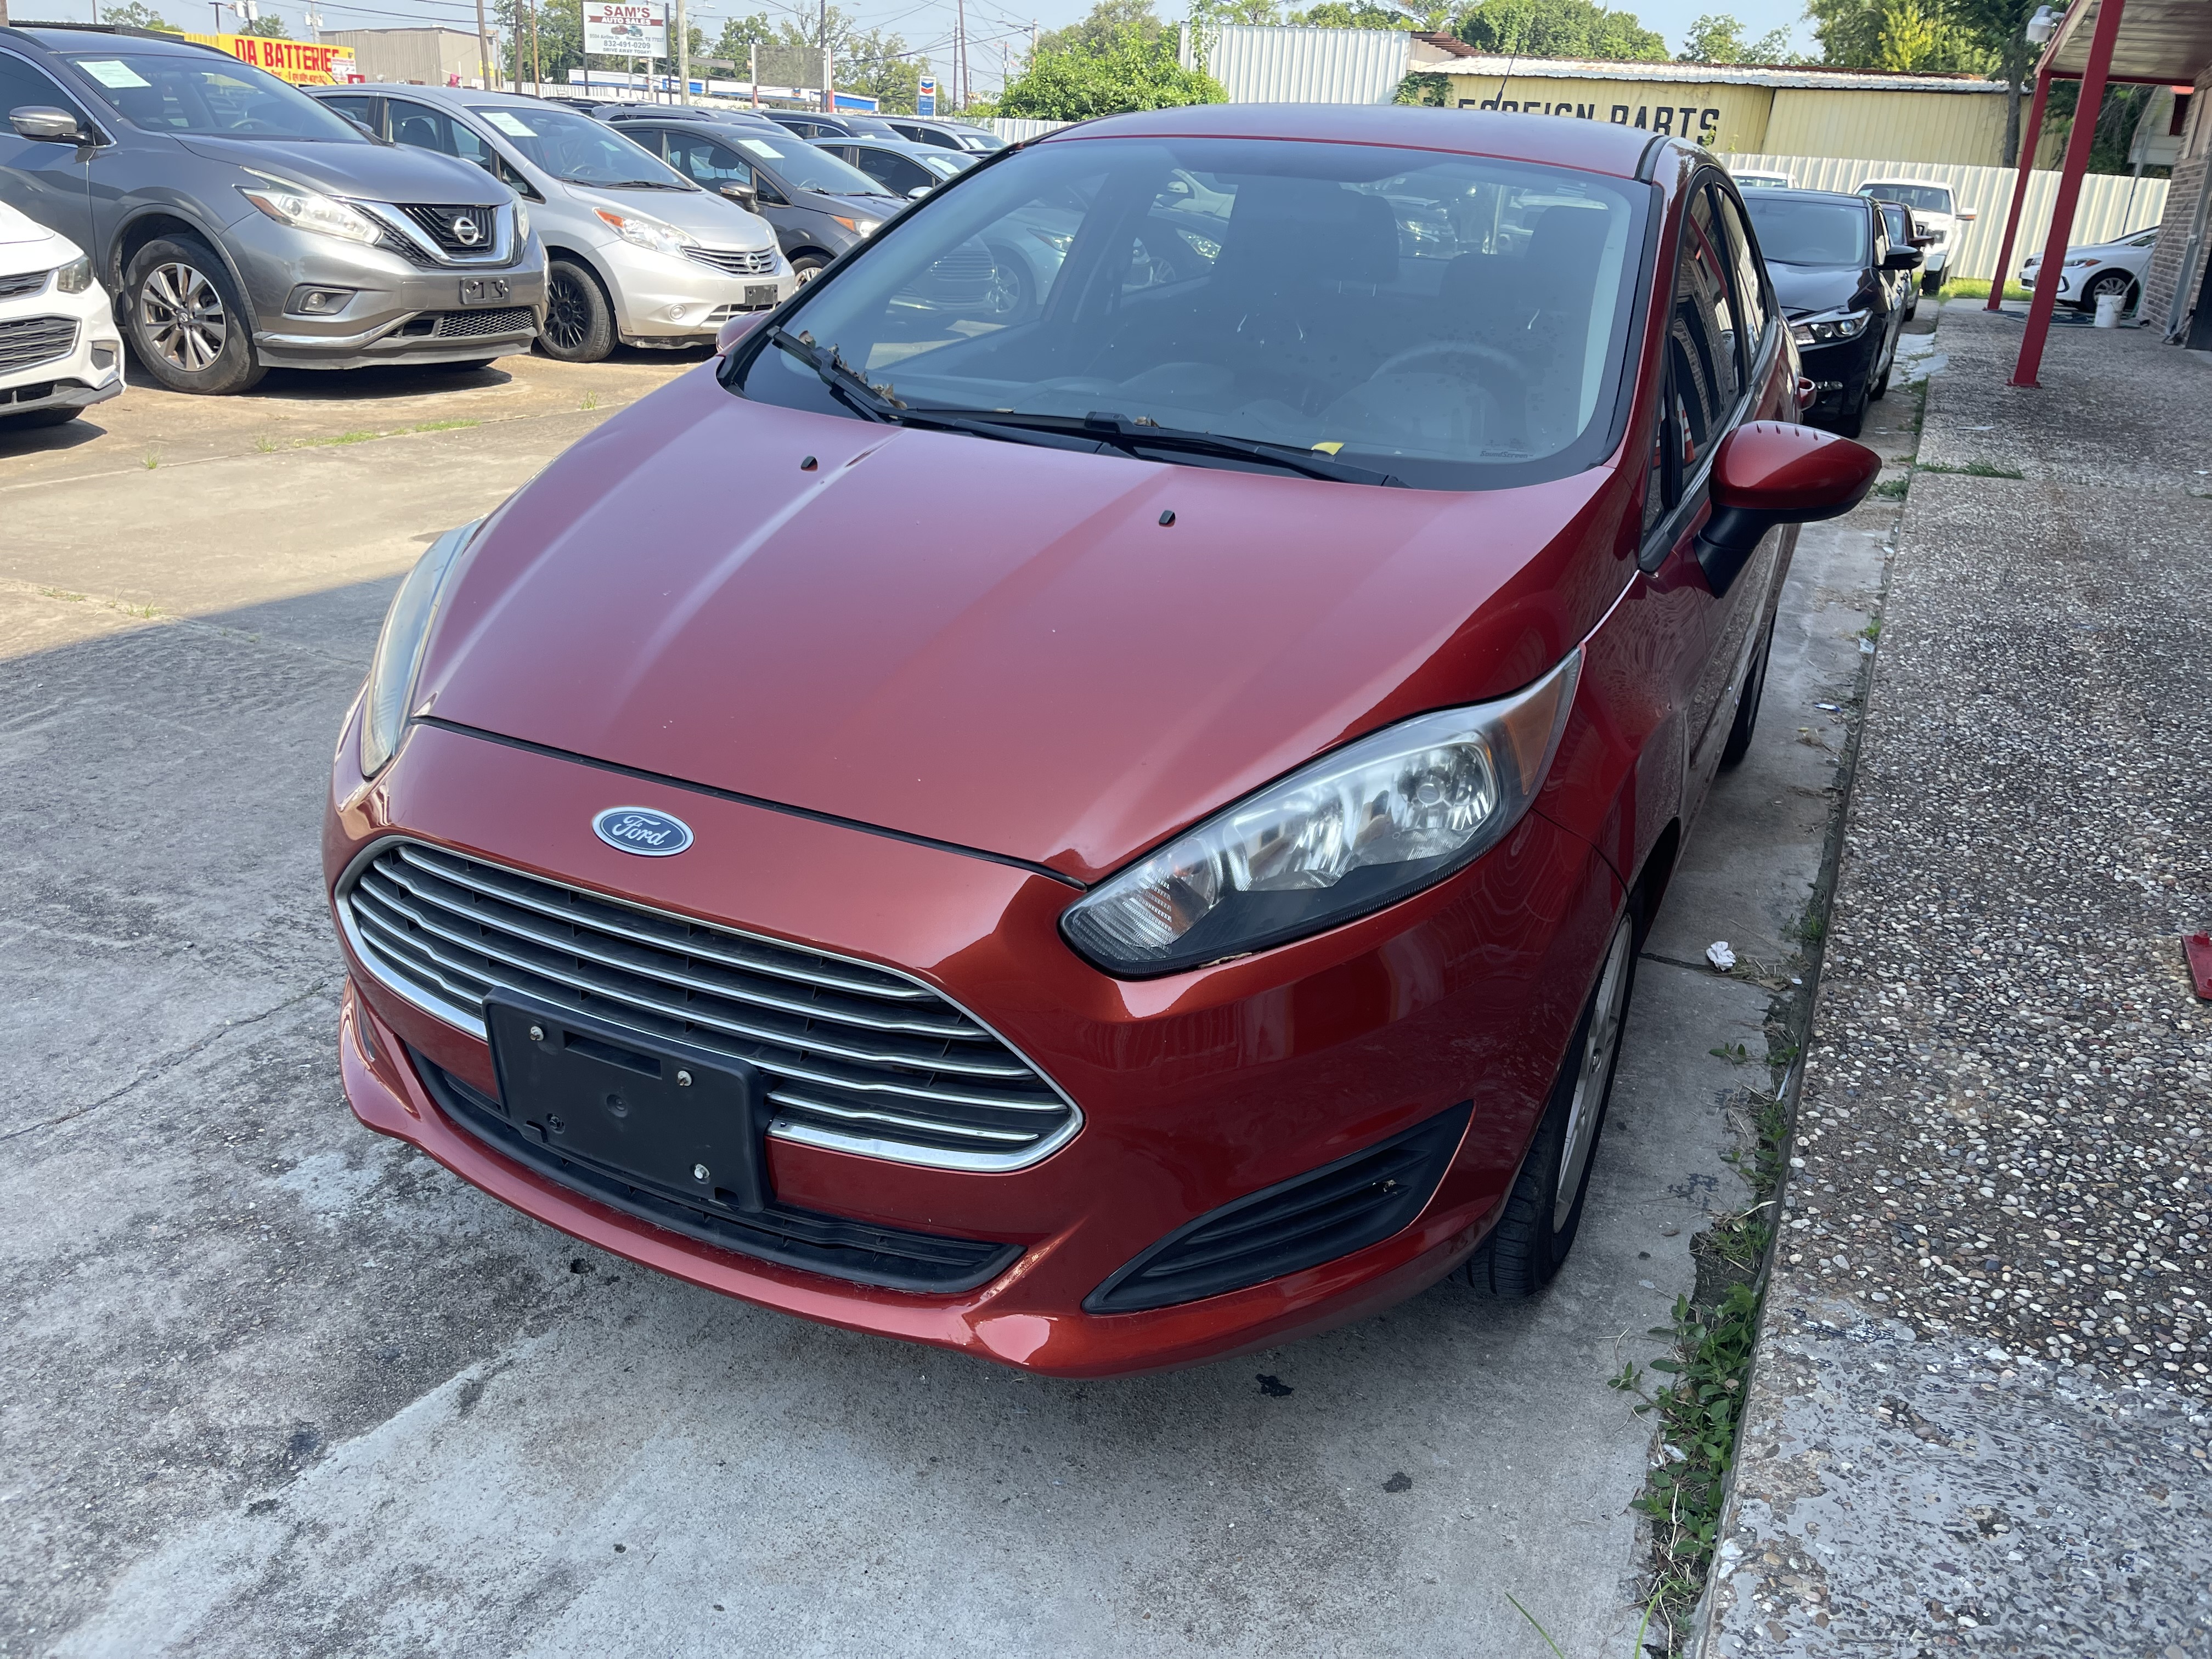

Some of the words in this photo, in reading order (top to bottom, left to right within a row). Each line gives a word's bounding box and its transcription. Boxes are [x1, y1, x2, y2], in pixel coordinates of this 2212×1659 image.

[603, 5, 651, 18] SAM'S
[603, 40, 651, 49] 832-491-0209
[612, 815, 672, 845] Ford
